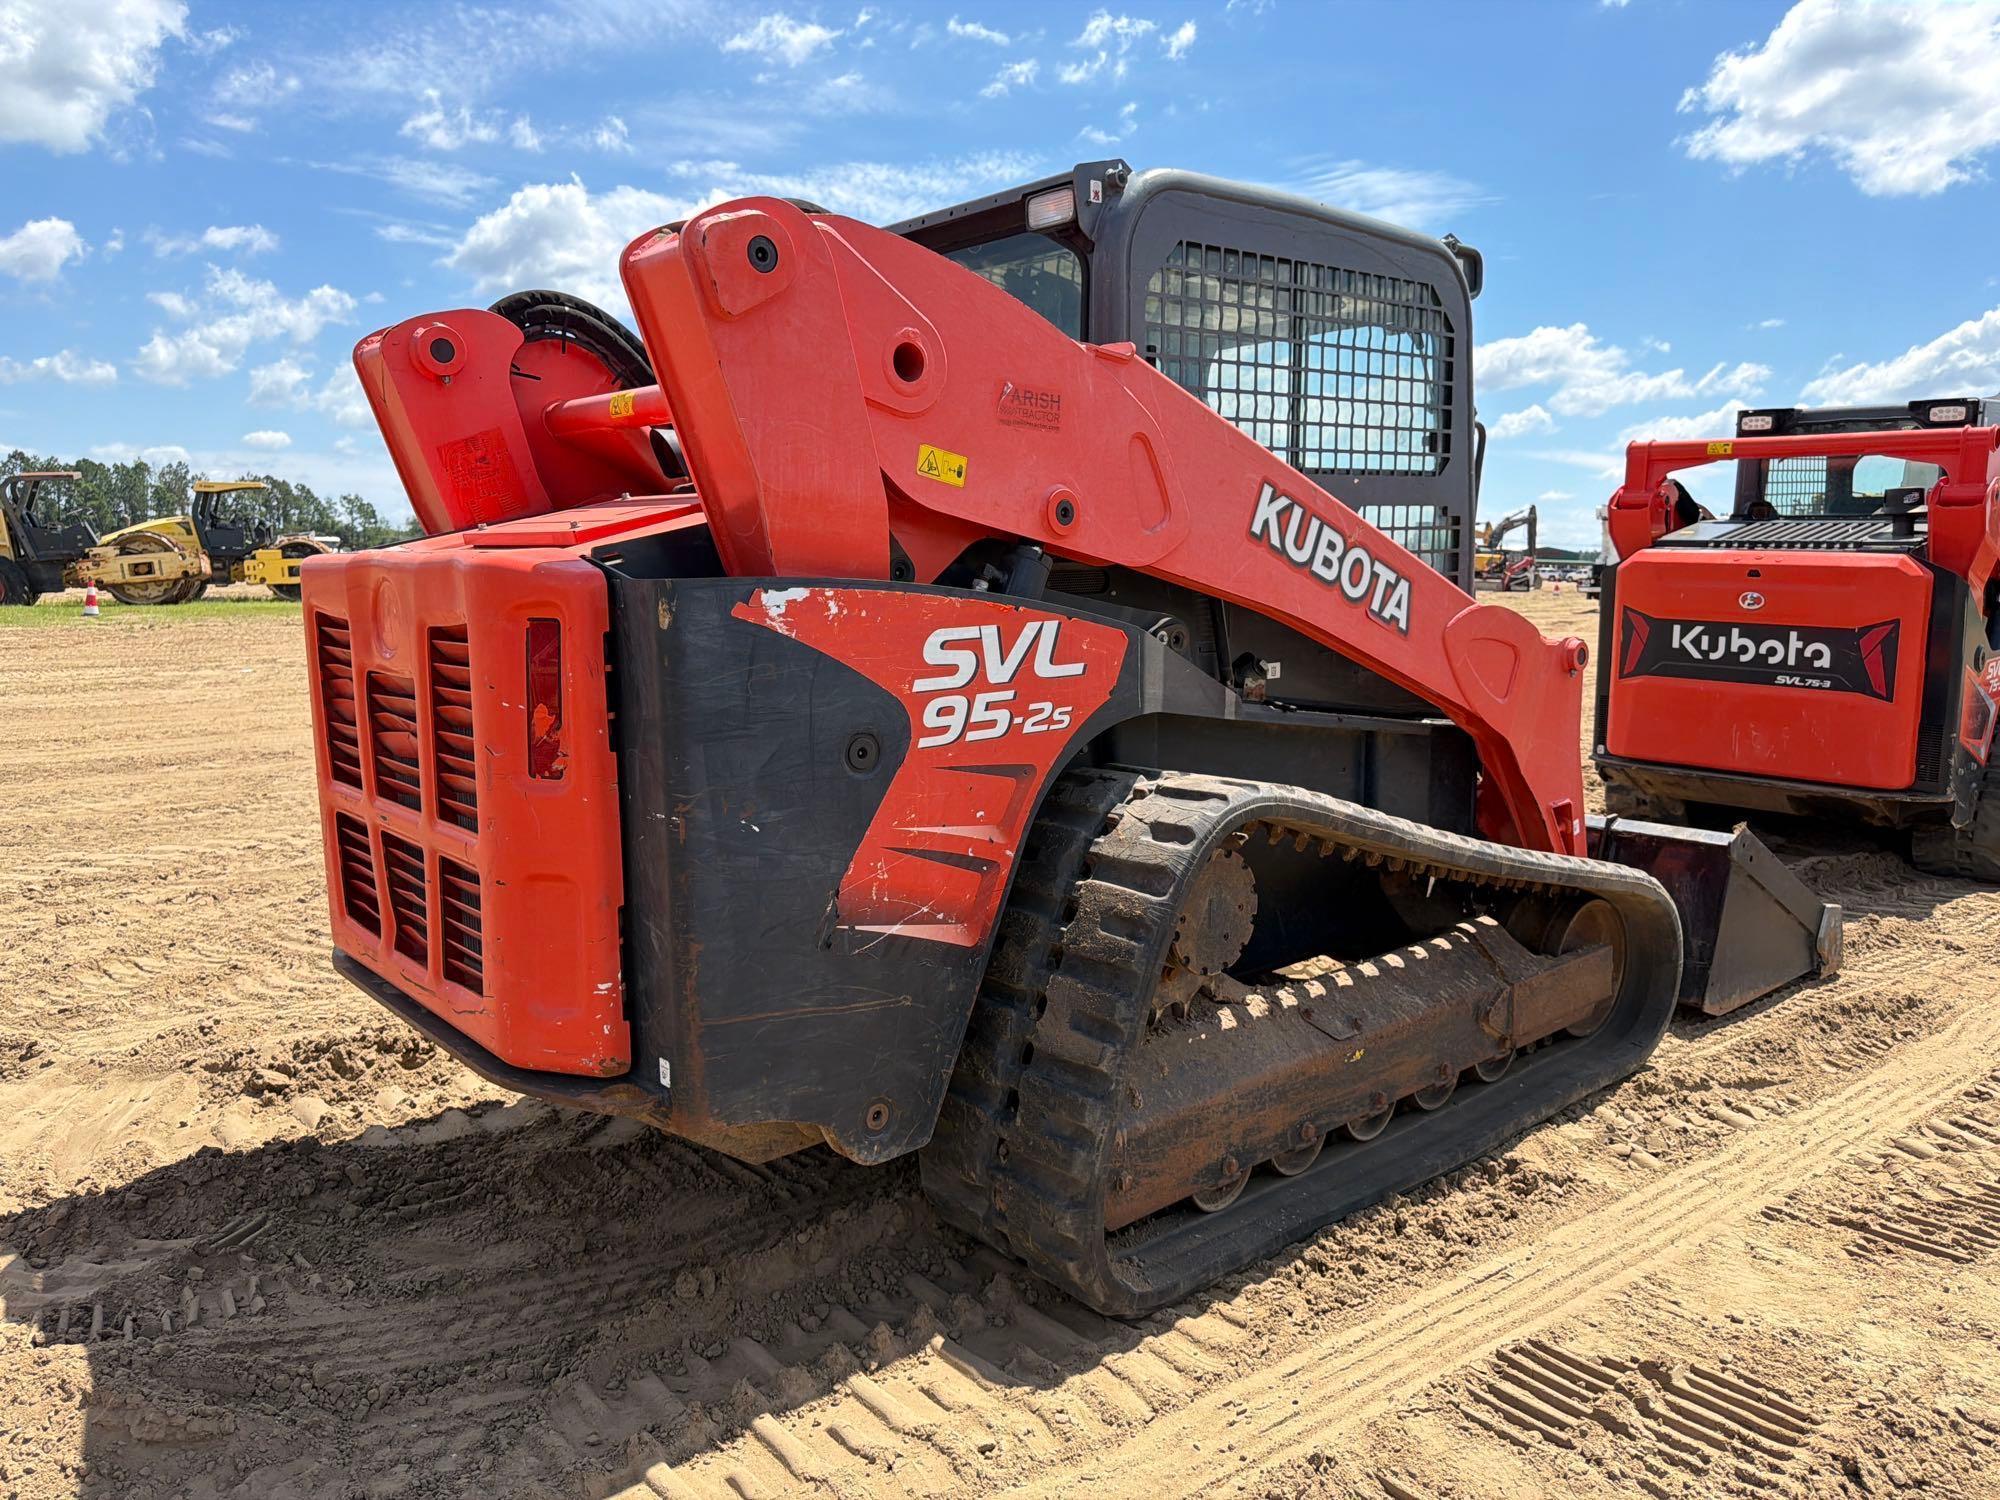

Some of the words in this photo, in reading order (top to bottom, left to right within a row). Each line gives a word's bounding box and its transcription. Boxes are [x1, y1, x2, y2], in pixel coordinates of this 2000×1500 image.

[1250, 482, 1411, 633] KUBOTA
[912, 620, 1087, 693] SVL
[1671, 624, 1831, 669] Kubota
